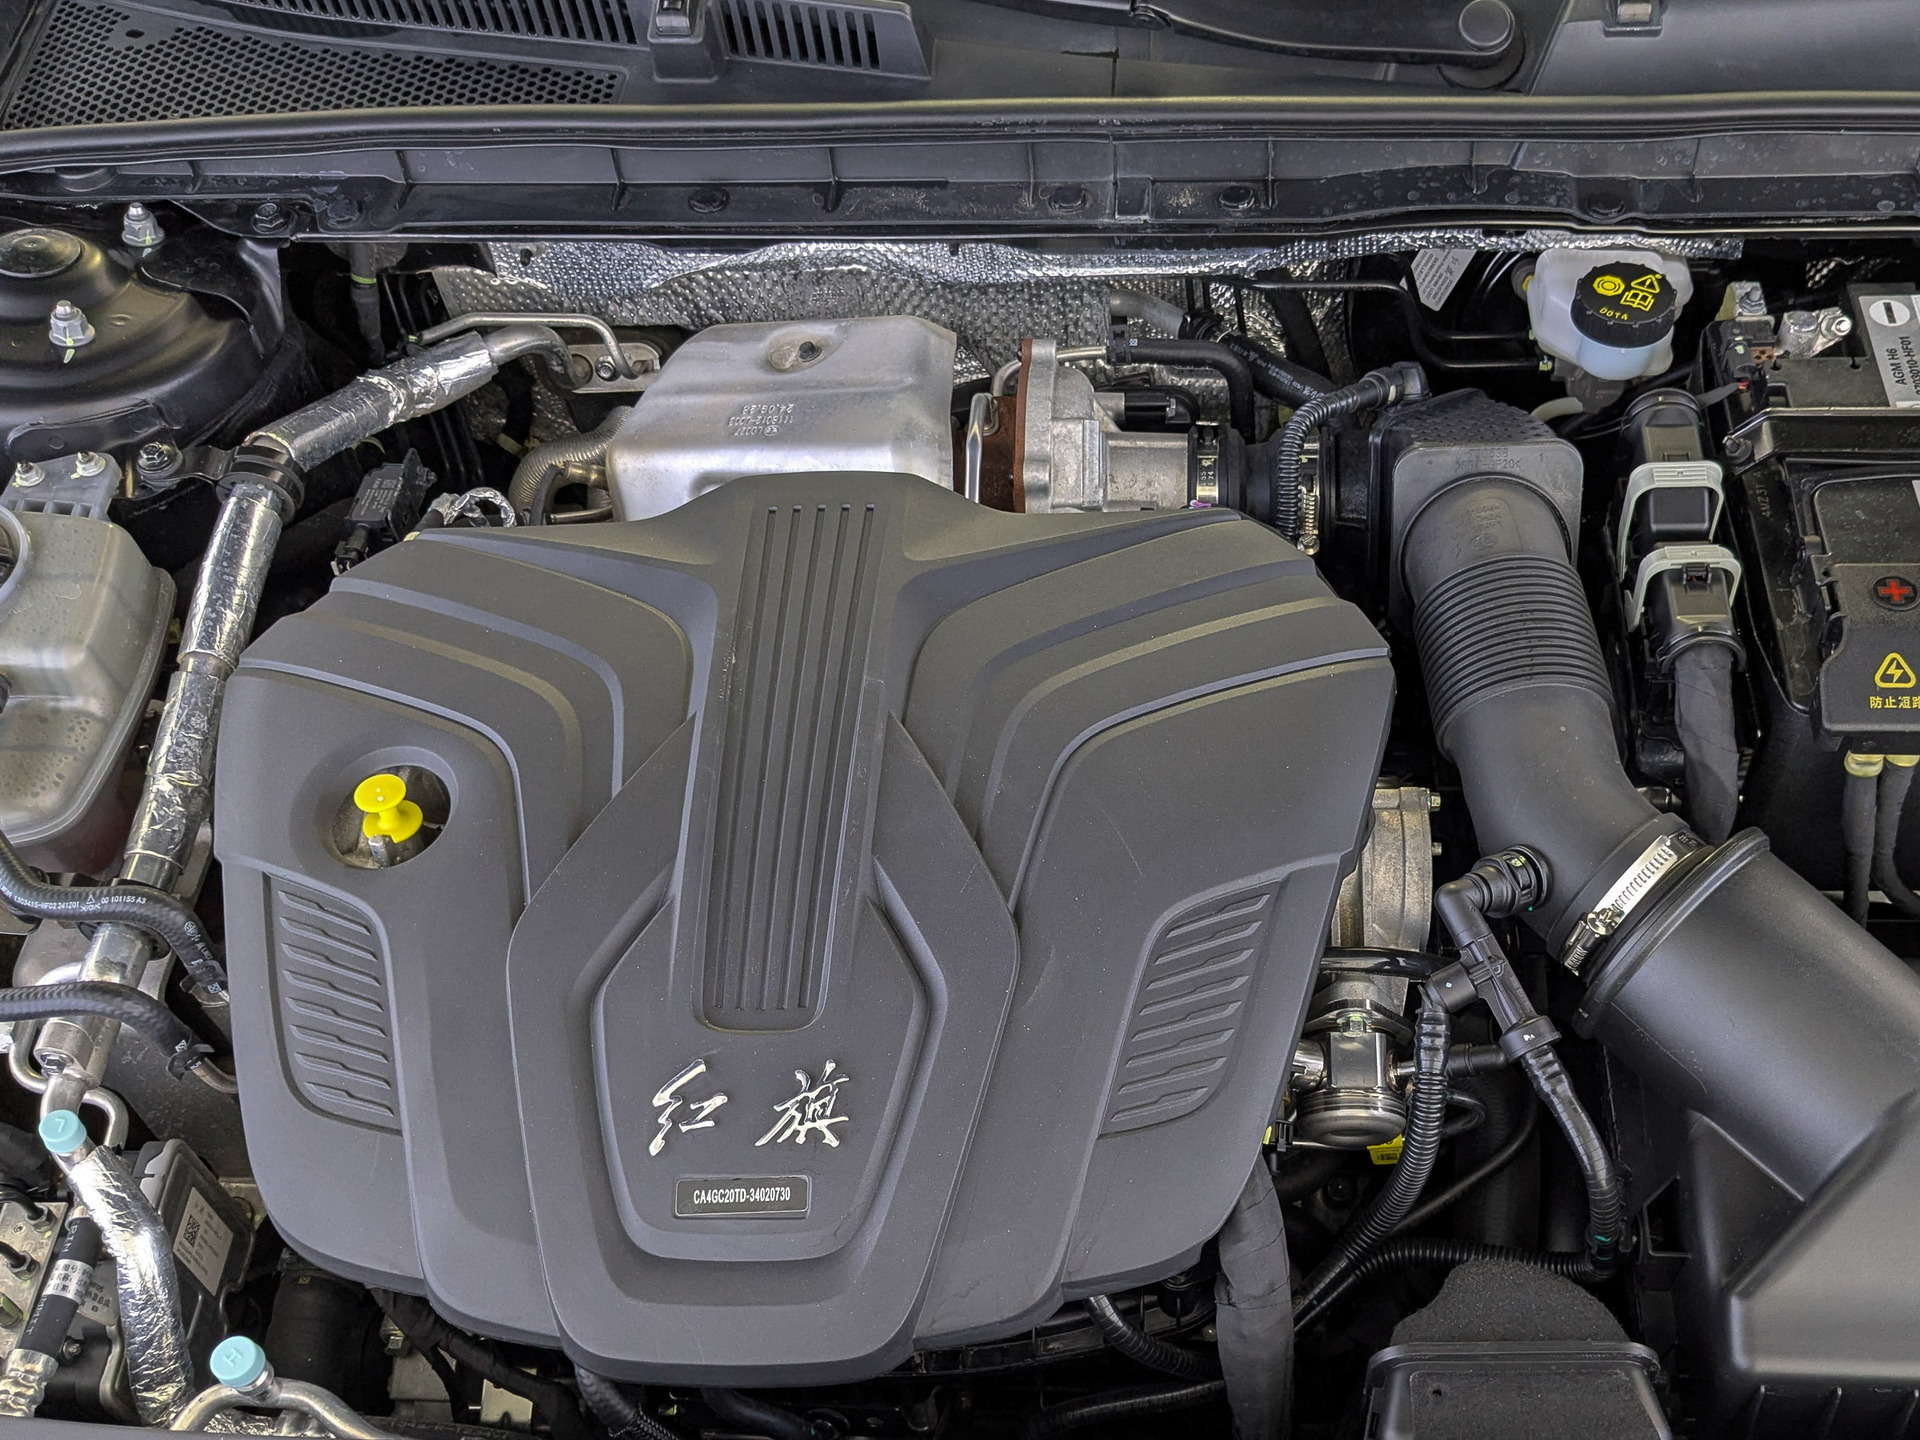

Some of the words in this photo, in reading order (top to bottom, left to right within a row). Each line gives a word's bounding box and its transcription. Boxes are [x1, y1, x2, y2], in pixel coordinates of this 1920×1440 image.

[1600, 307, 1628, 320] DOT4
[1886, 347, 1900, 361] H6
[1890, 362, 1907, 385] AGM
[648, 1058, 850, 1157] 红旗
[693, 1186, 791, 1204] CA4GC20TD-34020730
[223, 1347, 242, 1368] H
